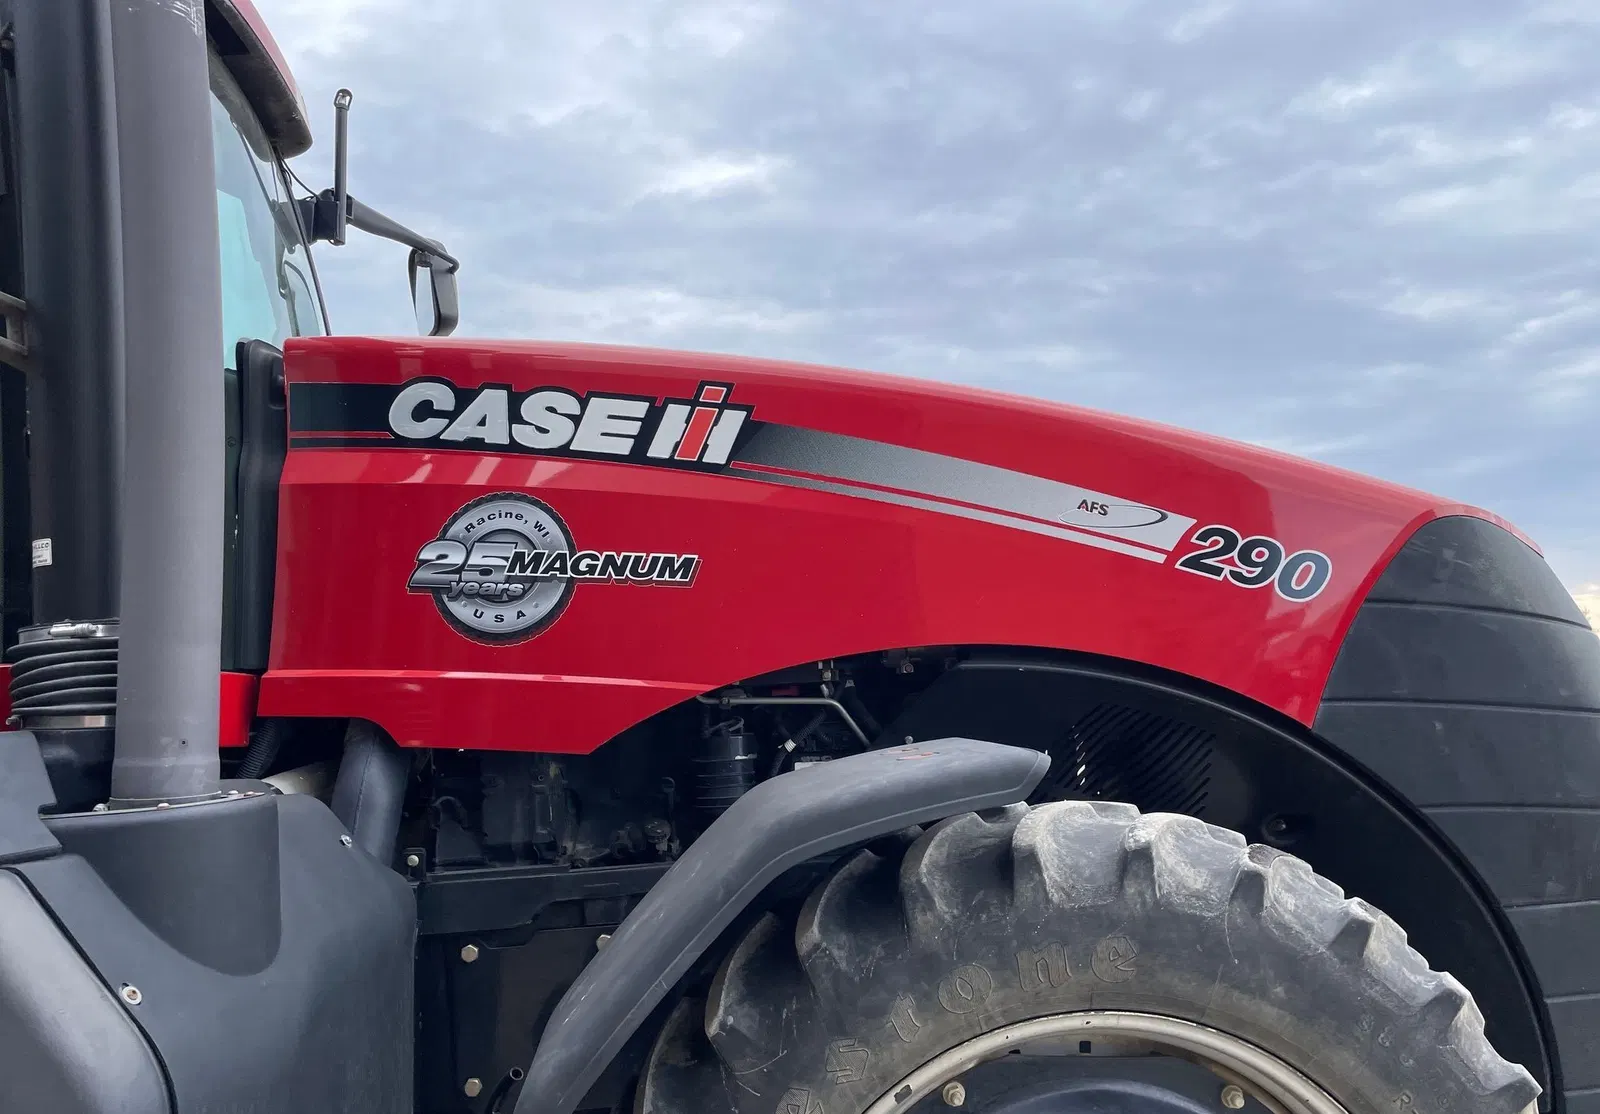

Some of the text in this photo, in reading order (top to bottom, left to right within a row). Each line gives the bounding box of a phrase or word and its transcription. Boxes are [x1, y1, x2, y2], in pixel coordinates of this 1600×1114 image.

[388, 381, 650, 455] CASE
[464, 510, 550, 538] Racine, WI
[1077, 499, 1109, 516] AFS
[407, 539, 518, 589] 25
[505, 549, 699, 582] MAGNUM
[1174, 524, 1332, 602] 290
[448, 580, 524, 600] years
